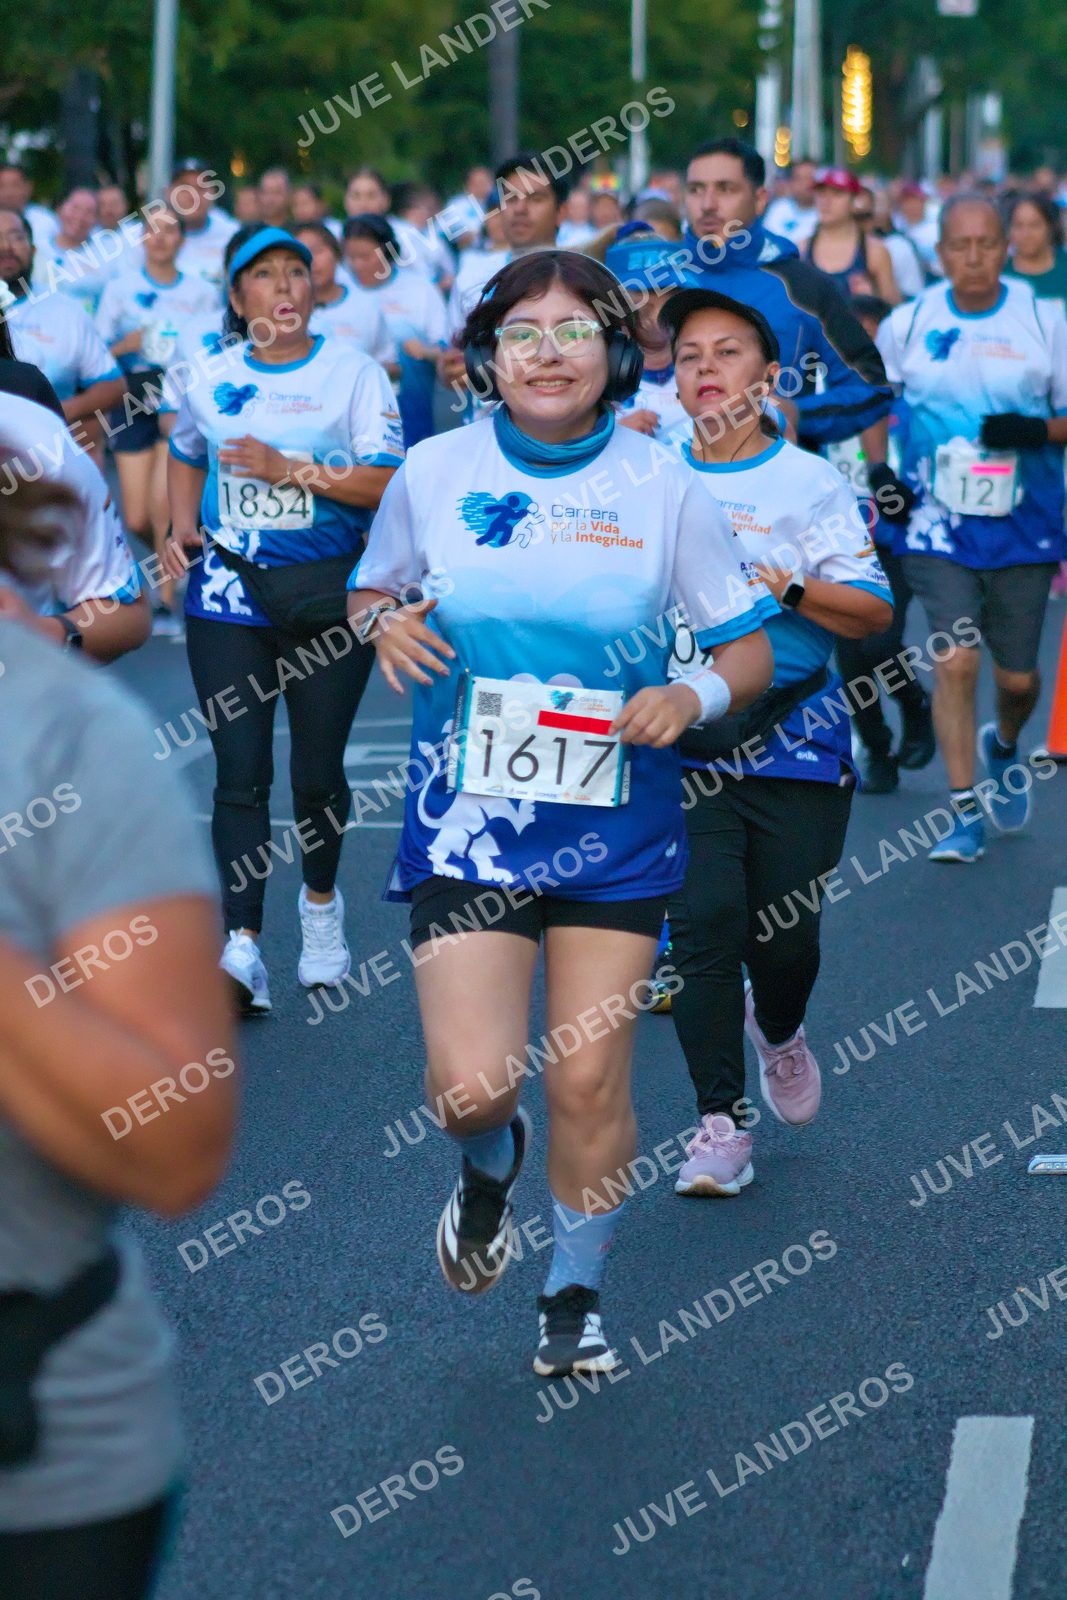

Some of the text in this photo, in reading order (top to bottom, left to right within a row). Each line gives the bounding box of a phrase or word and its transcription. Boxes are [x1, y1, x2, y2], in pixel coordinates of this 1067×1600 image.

[960, 476, 995, 506] 12
[222, 482, 310, 519] 1854
[713, 497, 757, 513] arrera
[551, 504, 619, 522] Carrera
[551, 520, 620, 534] por la Vida
[550, 532, 643, 549] y la Integridad
[480, 728, 618, 788] 1617
